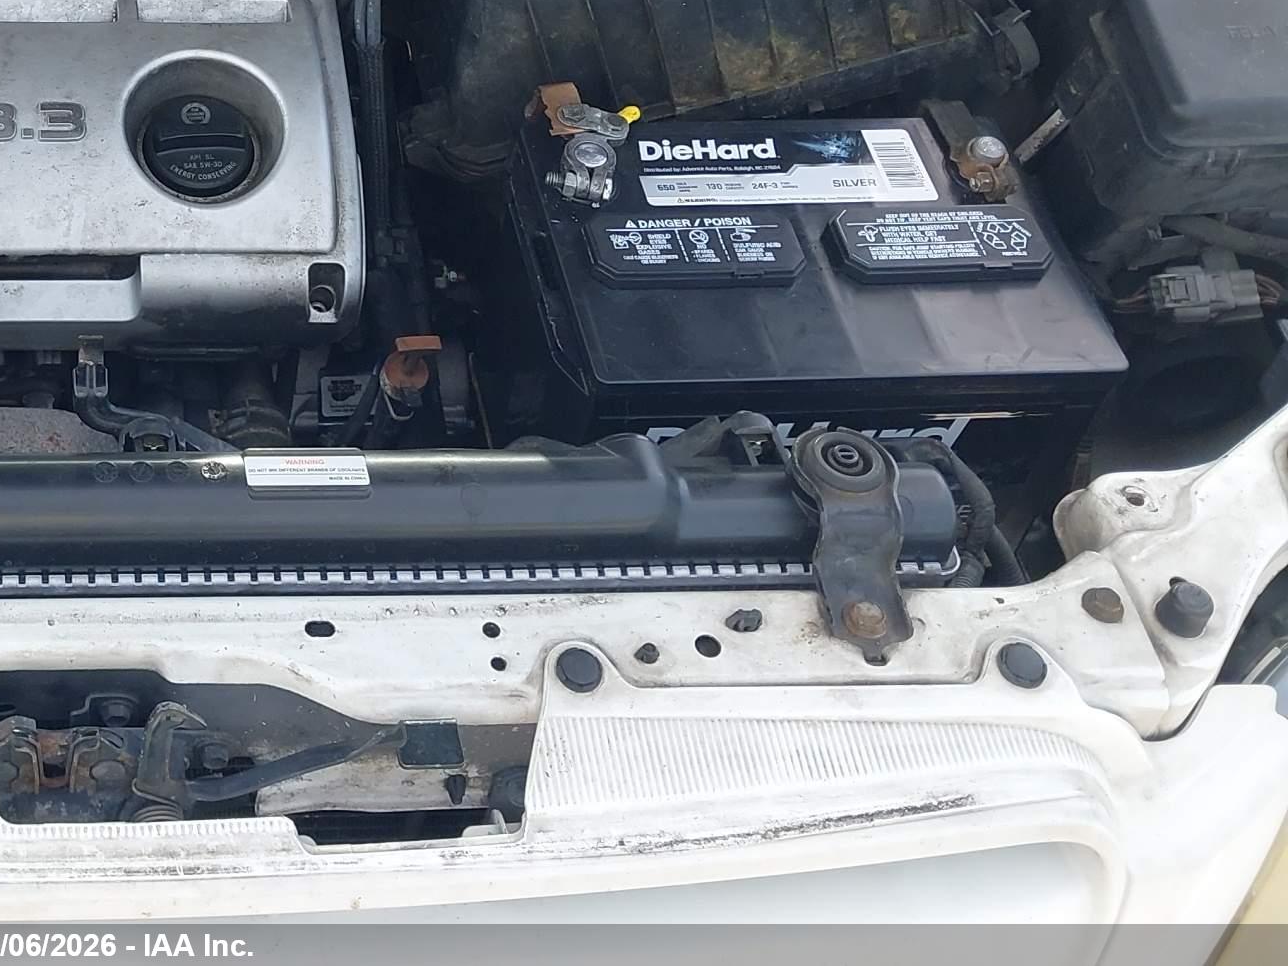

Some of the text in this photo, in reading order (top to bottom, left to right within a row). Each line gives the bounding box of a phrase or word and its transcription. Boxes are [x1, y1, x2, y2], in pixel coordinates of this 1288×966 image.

[638, 138, 777, 161] DieHard
[169, 161, 238, 181] ENERGY CONSERVING
[199, 161, 223, 169] 5W-30
[751, 182, 778, 190] 24F-3
[832, 178, 877, 188] SILVER
[638, 217, 752, 229] DANGER / POISON
